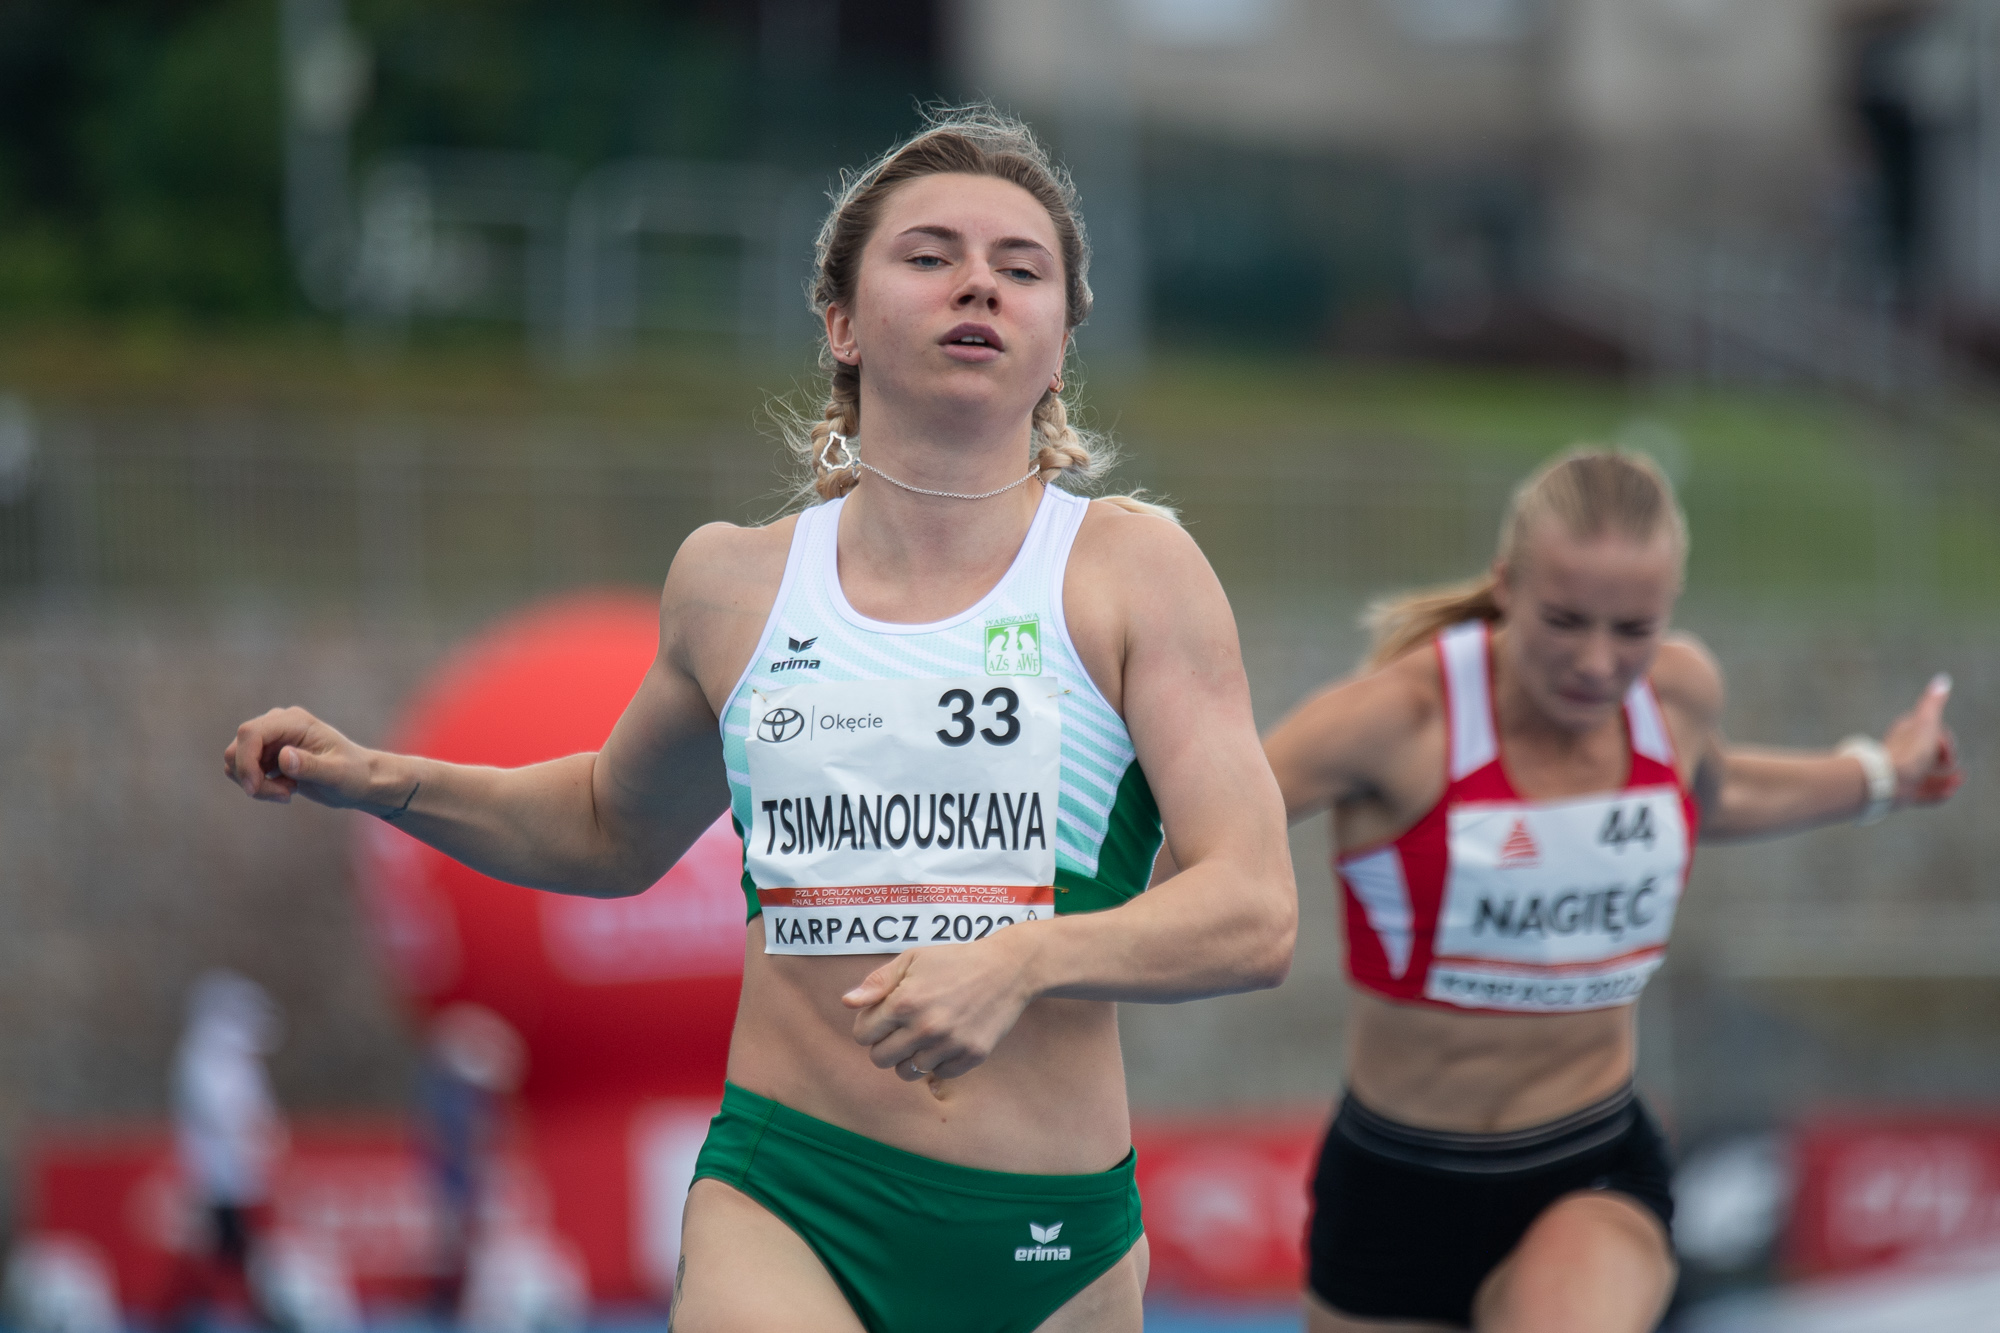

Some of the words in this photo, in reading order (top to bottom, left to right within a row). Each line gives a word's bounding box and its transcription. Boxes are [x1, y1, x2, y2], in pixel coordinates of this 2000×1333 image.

[985, 613, 1039, 626] WARSZAWA
[770, 657, 821, 673] erima
[988, 654, 1009, 672] AZS
[820, 713, 884, 733] Okęcie
[935, 686, 1021, 748] 33
[762, 792, 1047, 855] TSIMANOUSKAYA
[1599, 806, 1655, 852] 44
[795, 889, 820, 898] PZLA
[890, 886, 967, 894] MISTRZOSTWA
[969, 886, 1008, 895] POLSKI
[816, 896, 889, 906] EKSTRAKLASY
[890, 895, 909, 903] LIGI
[911, 895, 1016, 904] LEKKOATLETYCZNEJ
[1472, 876, 1657, 943] NAGIĘĆ
[774, 915, 920, 946] KARPACZ
[1014, 1244, 1072, 1262] erima
